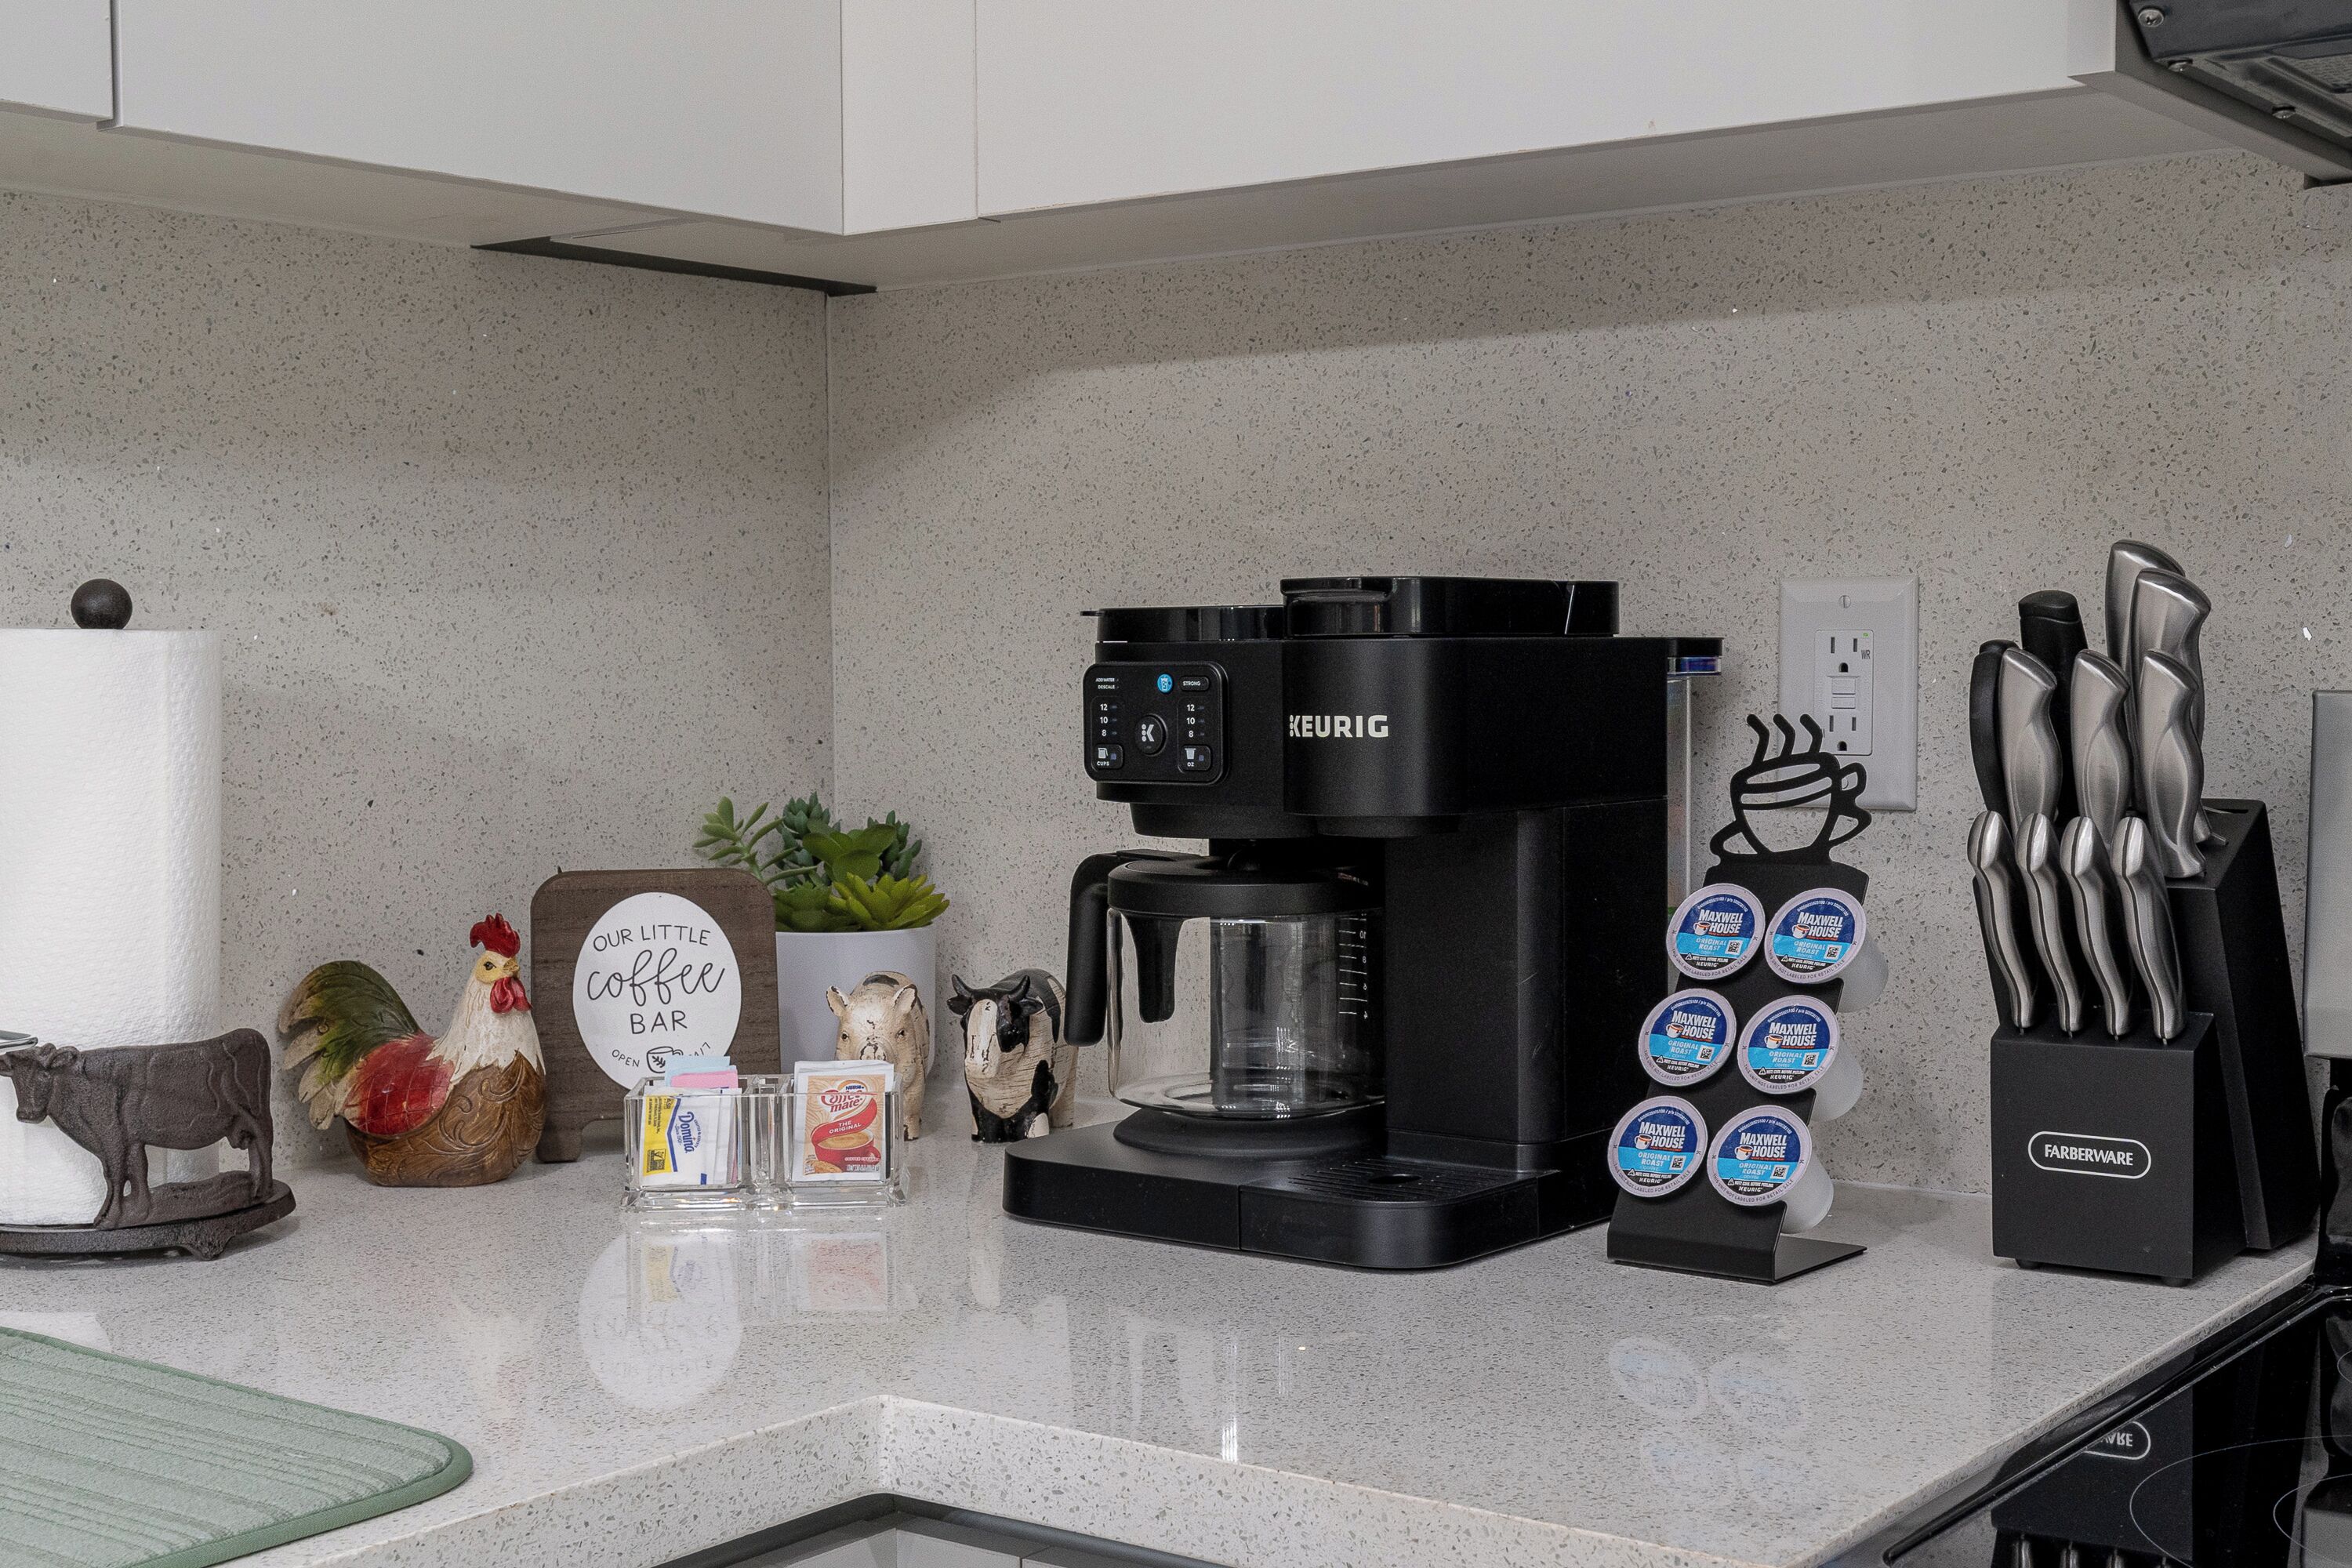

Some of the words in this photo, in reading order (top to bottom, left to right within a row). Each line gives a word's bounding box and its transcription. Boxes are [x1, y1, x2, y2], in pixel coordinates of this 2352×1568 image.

[1861, 649, 1871, 659] WR
[1289, 714, 1389, 738] KEURIG
[1699, 909, 1743, 923] MAXWELL
[1798, 912, 1843, 927] MAXWELL
[1710, 923, 1741, 933] HOUSE
[1809, 926, 1841, 938] HOUSE
[593, 928, 633, 952] OUR
[641, 924, 711, 946] LITTLE
[587, 947, 725, 1007] coffee
[630, 1010, 688, 1035] BAR
[1671, 1011, 1716, 1028] MAXWELL
[1682, 1025, 1715, 1040] HOUSE
[1769, 1022, 1817, 1035] MAXWELL
[1668, 1040, 1698, 1050] ORIGINAL
[1782, 1035, 1816, 1046] HOUSE
[612, 1049, 640, 1067] OPEN
[830, 1098, 860, 1112] mate
[678, 1111, 695, 1153] Domino
[829, 1123, 862, 1134] ORIGINAL
[1639, 1122, 1685, 1137] MAXWELL
[1651, 1137, 1684, 1149] HOUSE
[1740, 1133, 1787, 1145] MAXWELL
[1639, 1152, 1670, 1160] ORIGINAL
[1752, 1146, 1786, 1158] HOUSE
[2045, 1144, 2133, 1166] FARBERWARE
[1767, 1189, 1783, 1199] RETAIL
